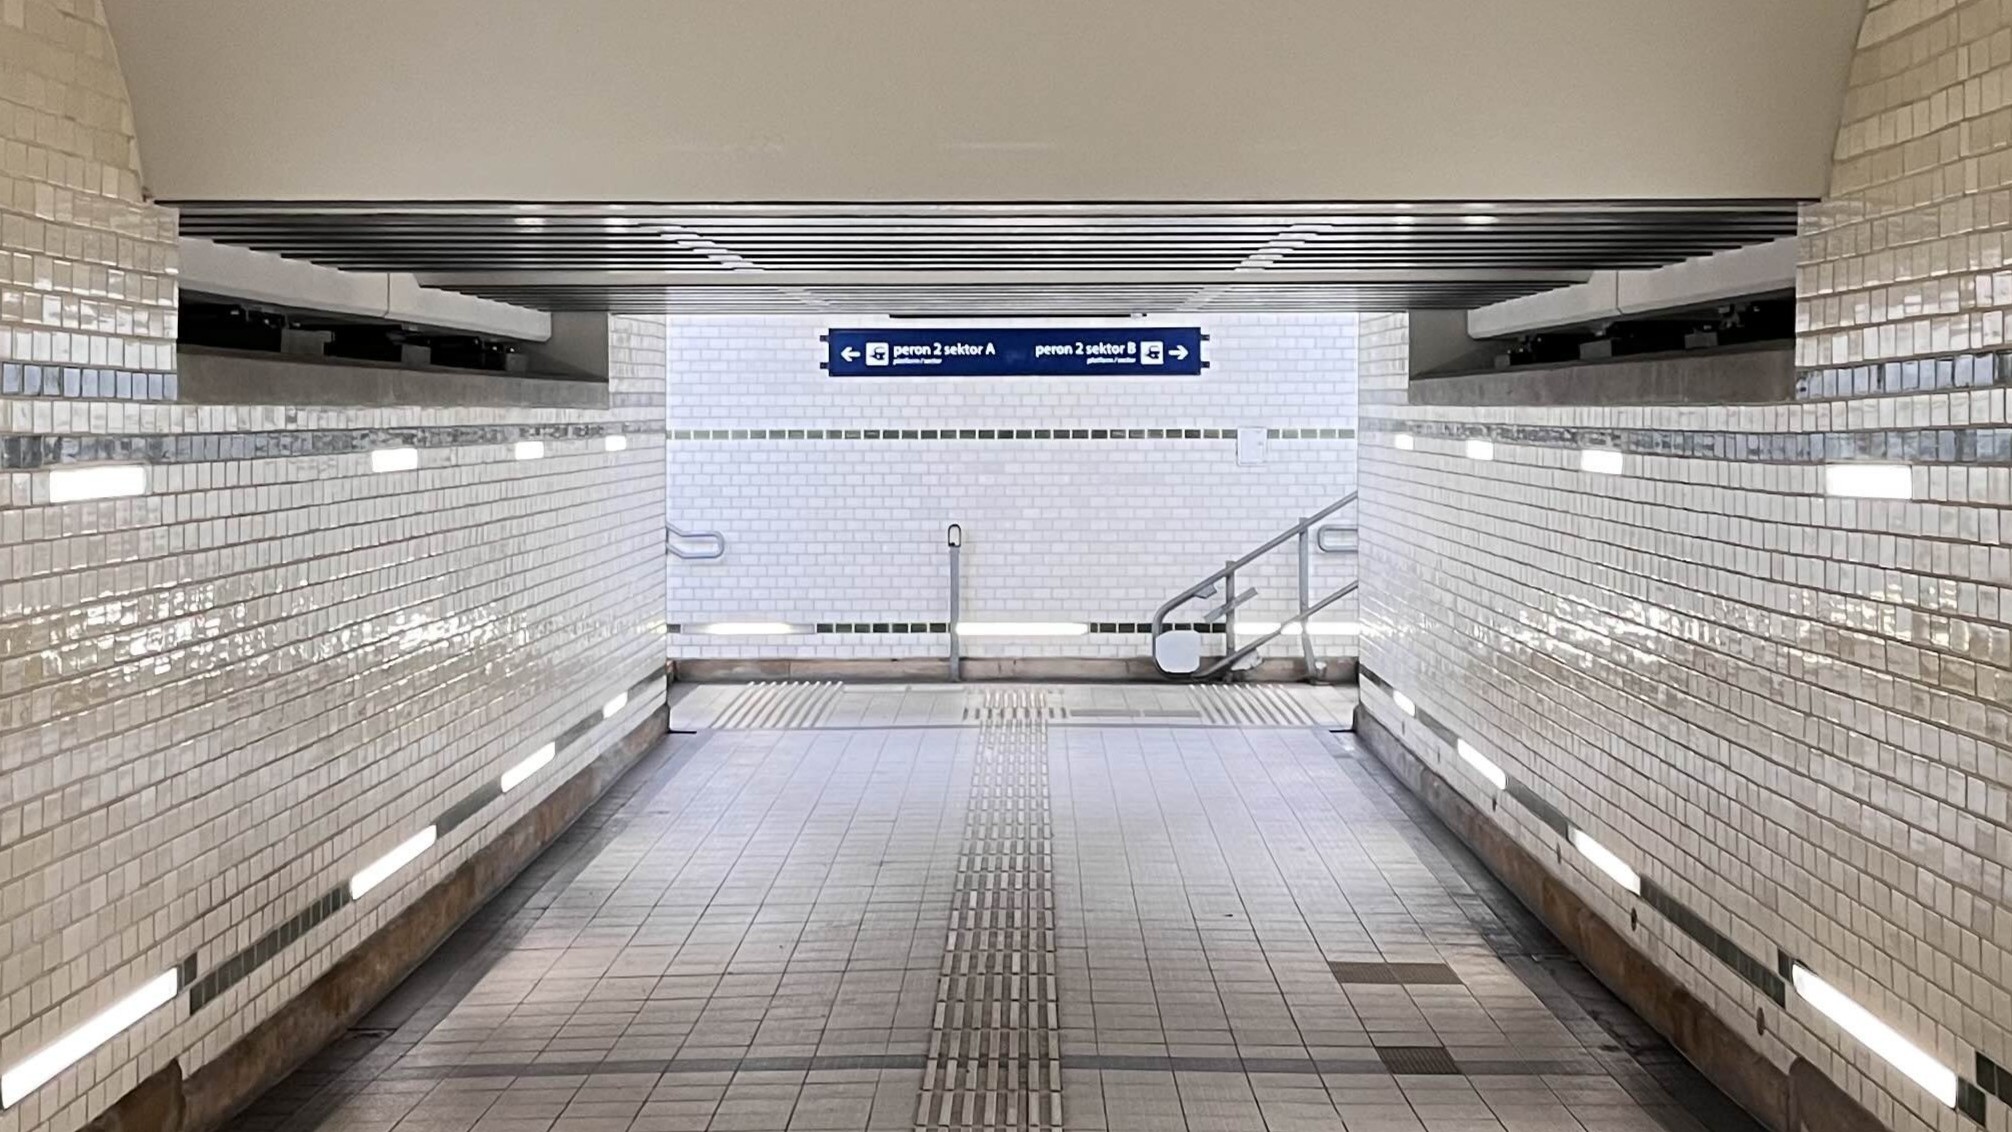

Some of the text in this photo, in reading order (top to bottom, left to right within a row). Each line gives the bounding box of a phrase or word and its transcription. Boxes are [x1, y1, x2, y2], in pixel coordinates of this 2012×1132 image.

[893, 342, 996, 358] peron 2 sektor A
[1035, 341, 1137, 358] peron 2 sektor B
